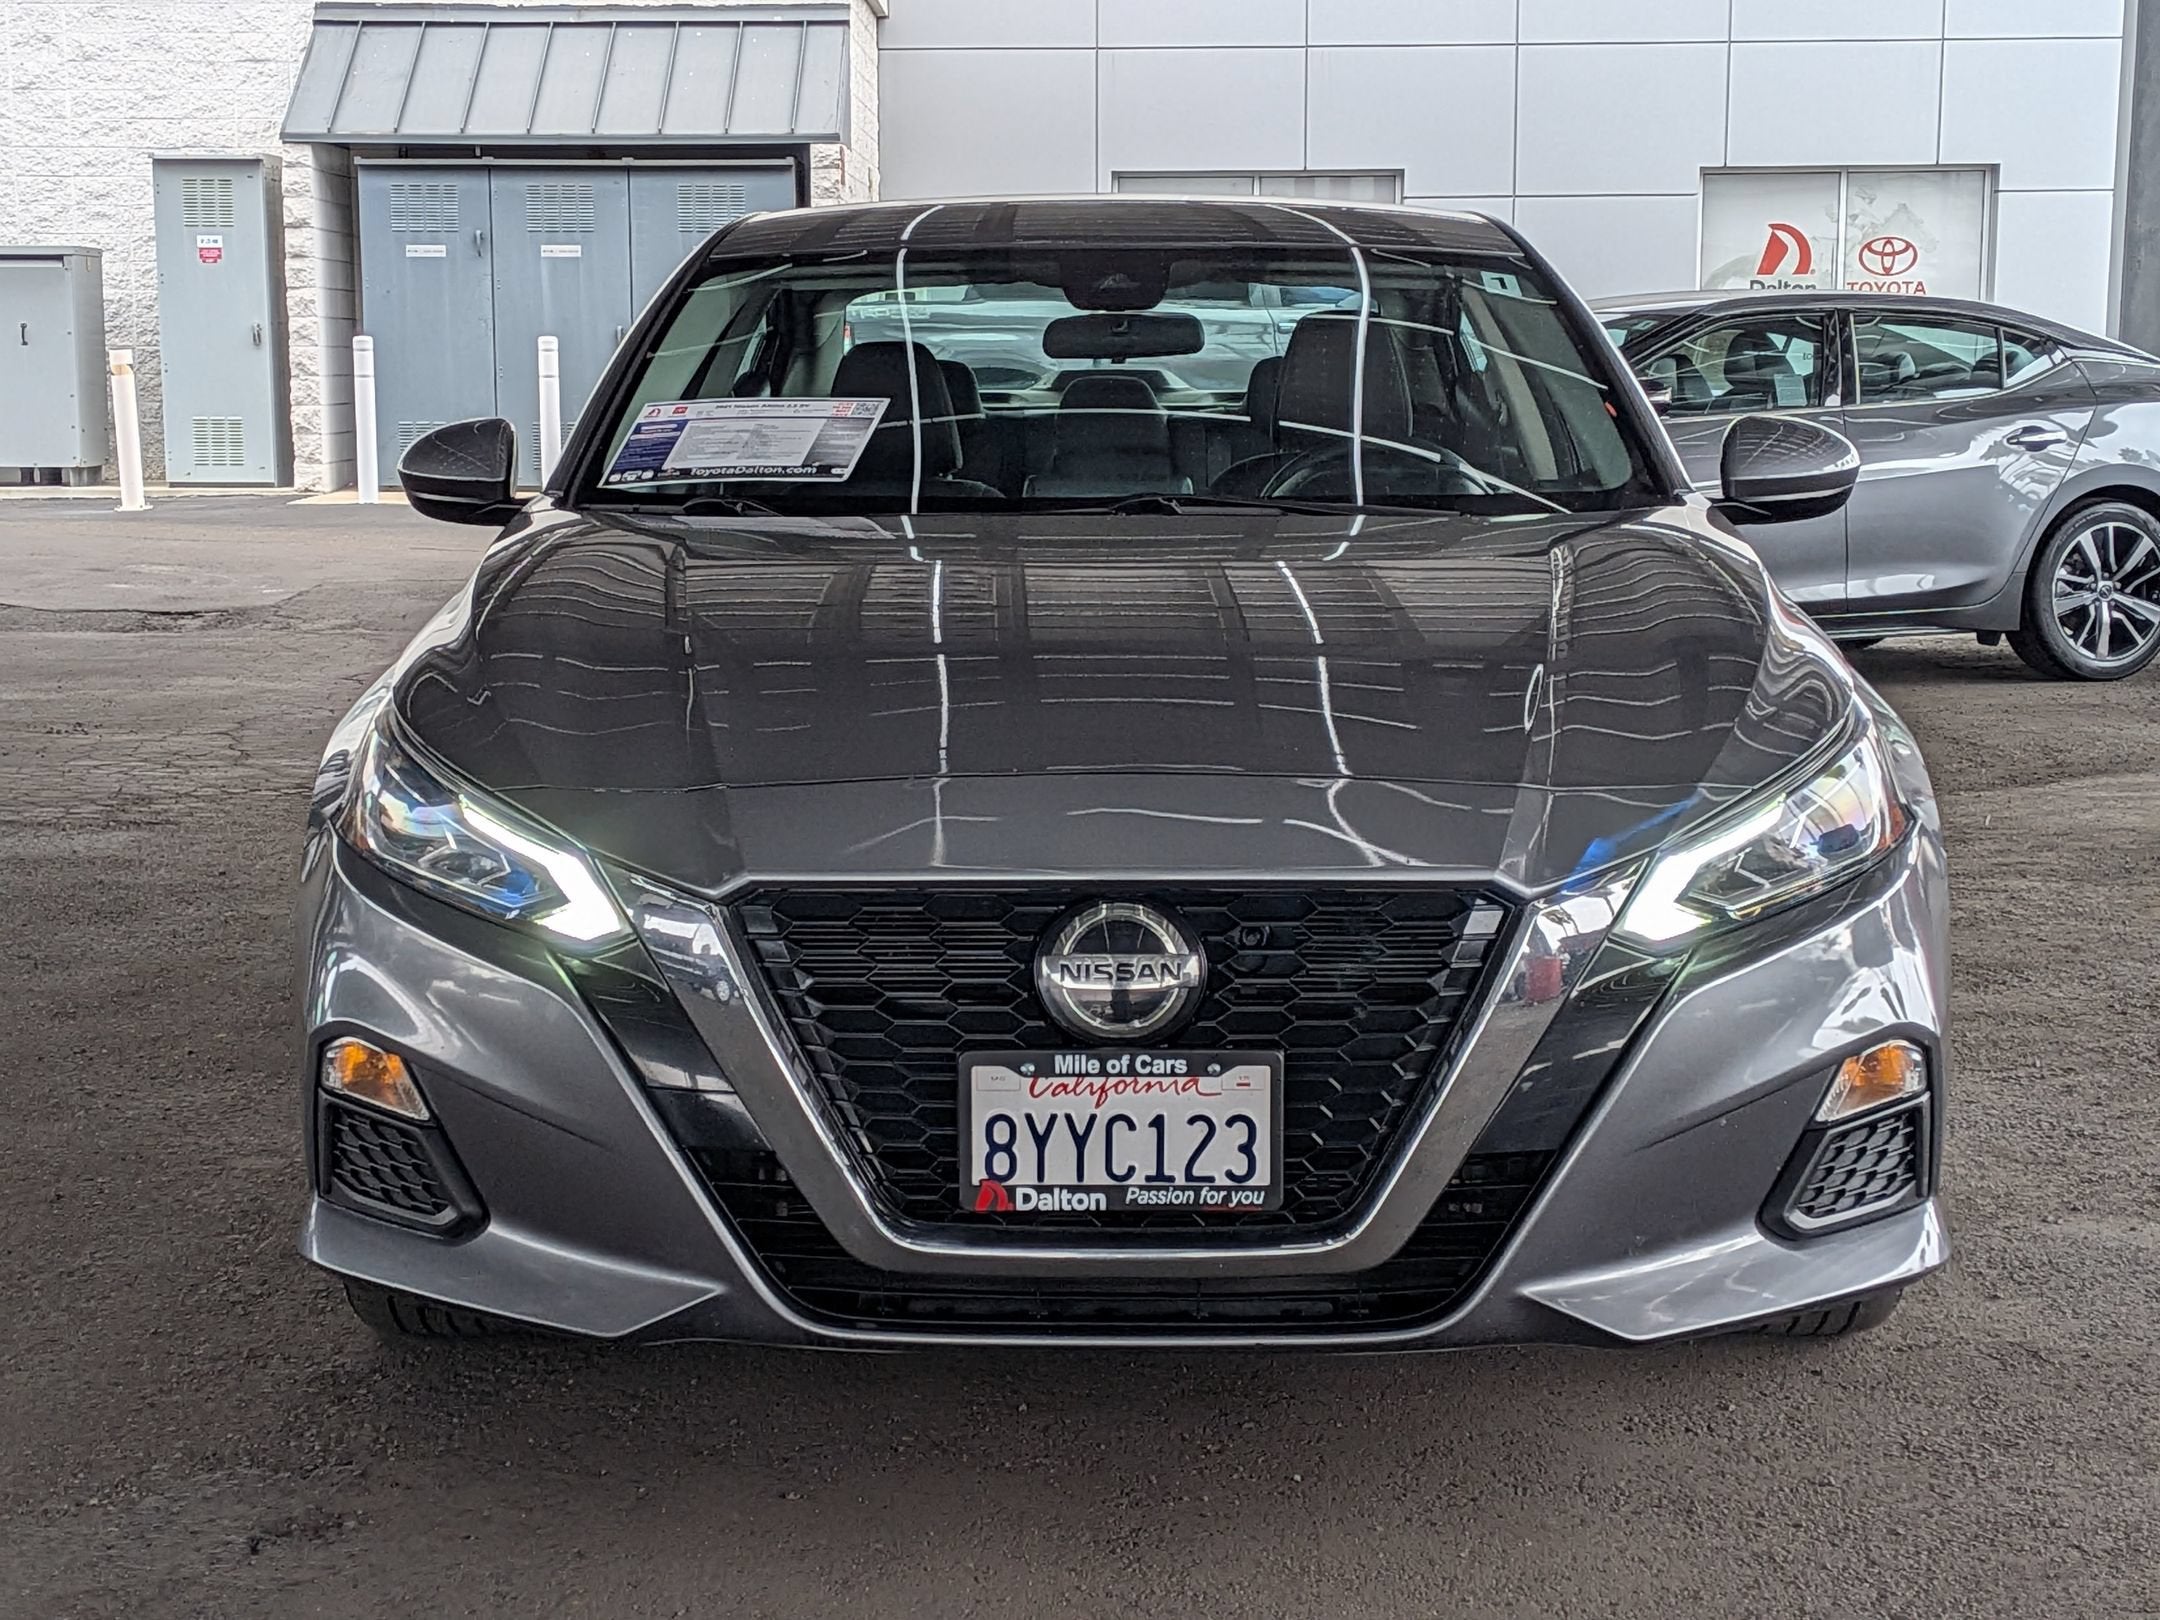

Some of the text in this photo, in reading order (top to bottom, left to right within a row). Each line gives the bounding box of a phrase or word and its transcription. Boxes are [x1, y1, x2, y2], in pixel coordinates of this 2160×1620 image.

[1847, 281, 1926, 295] TOYOTA
[690, 465, 817, 477] ToyotaDalton.com
[1060, 963, 1181, 982] NISSAN
[1054, 1054, 1188, 1075] Mile of Cars
[1028, 1076, 1222, 1109] California
[984, 1113, 1258, 1184] 8YYC123
[1015, 1187, 1107, 1211] Dalton
[1125, 1187, 1265, 1208] Passion for you
